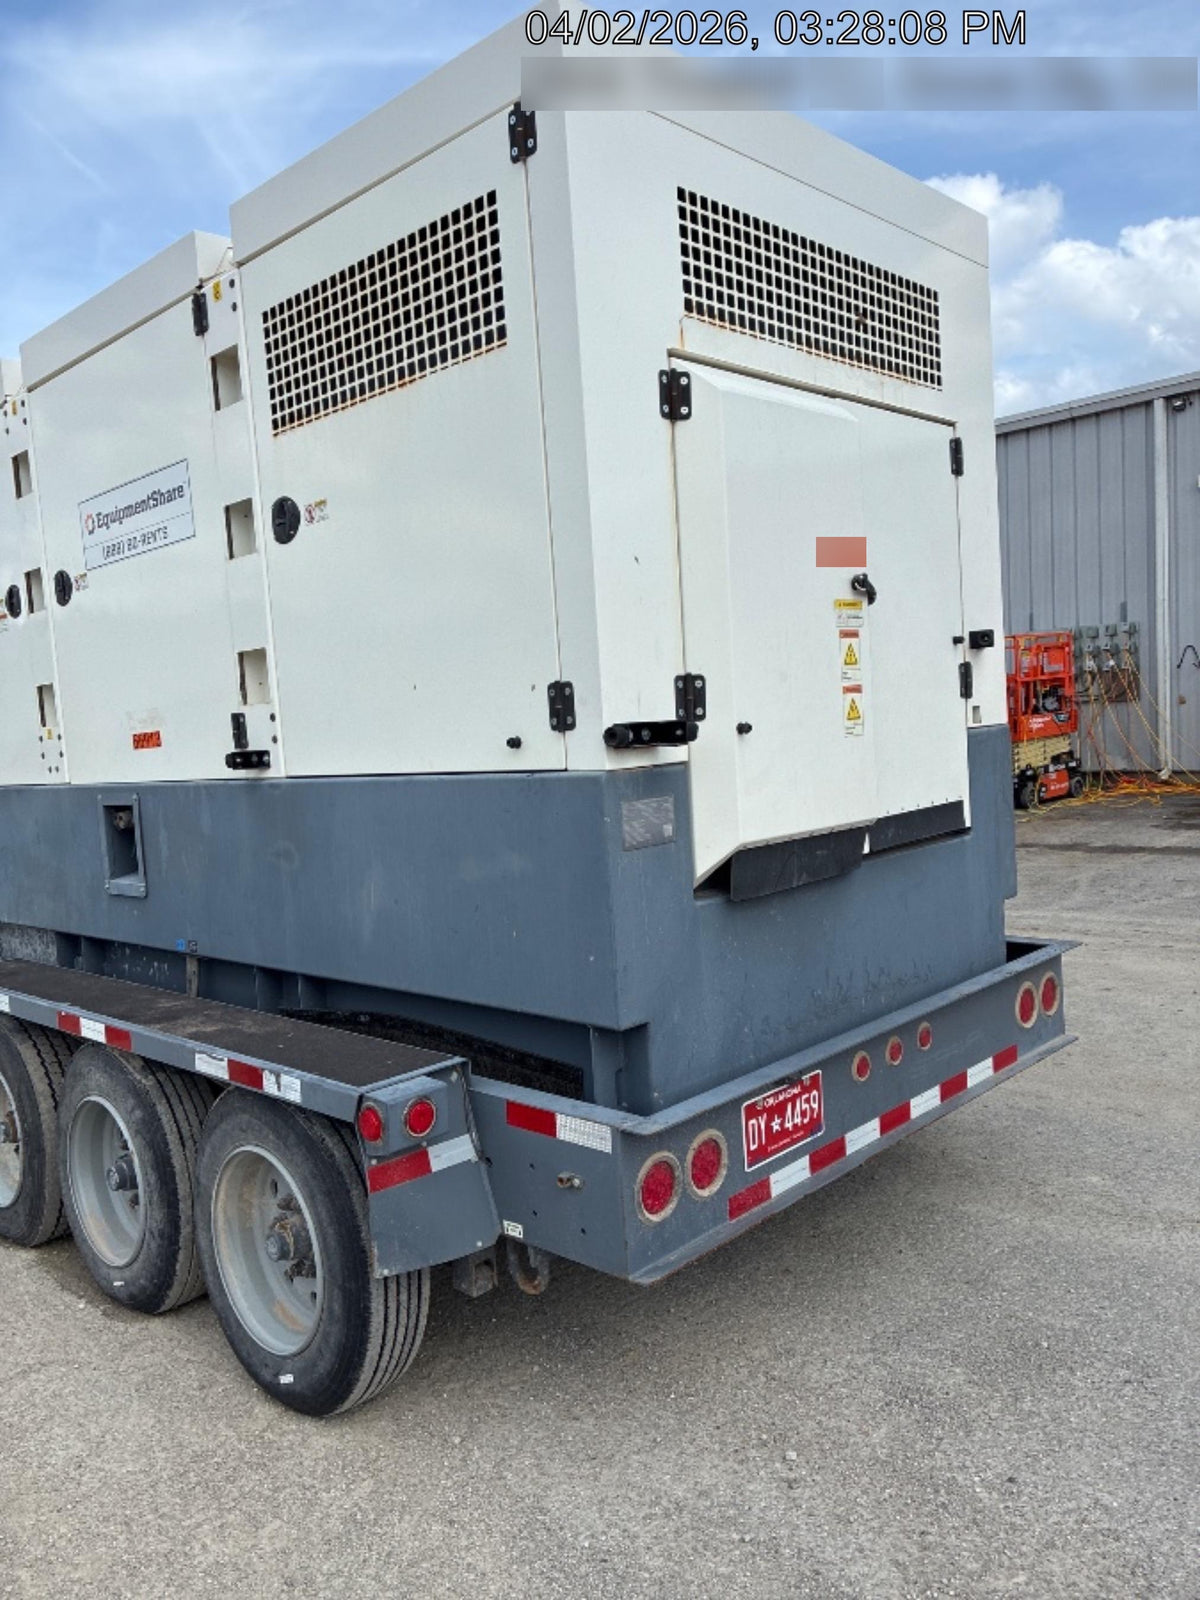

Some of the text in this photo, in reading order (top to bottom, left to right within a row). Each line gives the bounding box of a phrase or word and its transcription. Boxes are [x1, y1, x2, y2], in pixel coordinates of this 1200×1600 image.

[96, 484, 184, 530] EquipmentShare
[748, 1112, 767, 1151] DY
[784, 1089, 819, 1132] 4459
